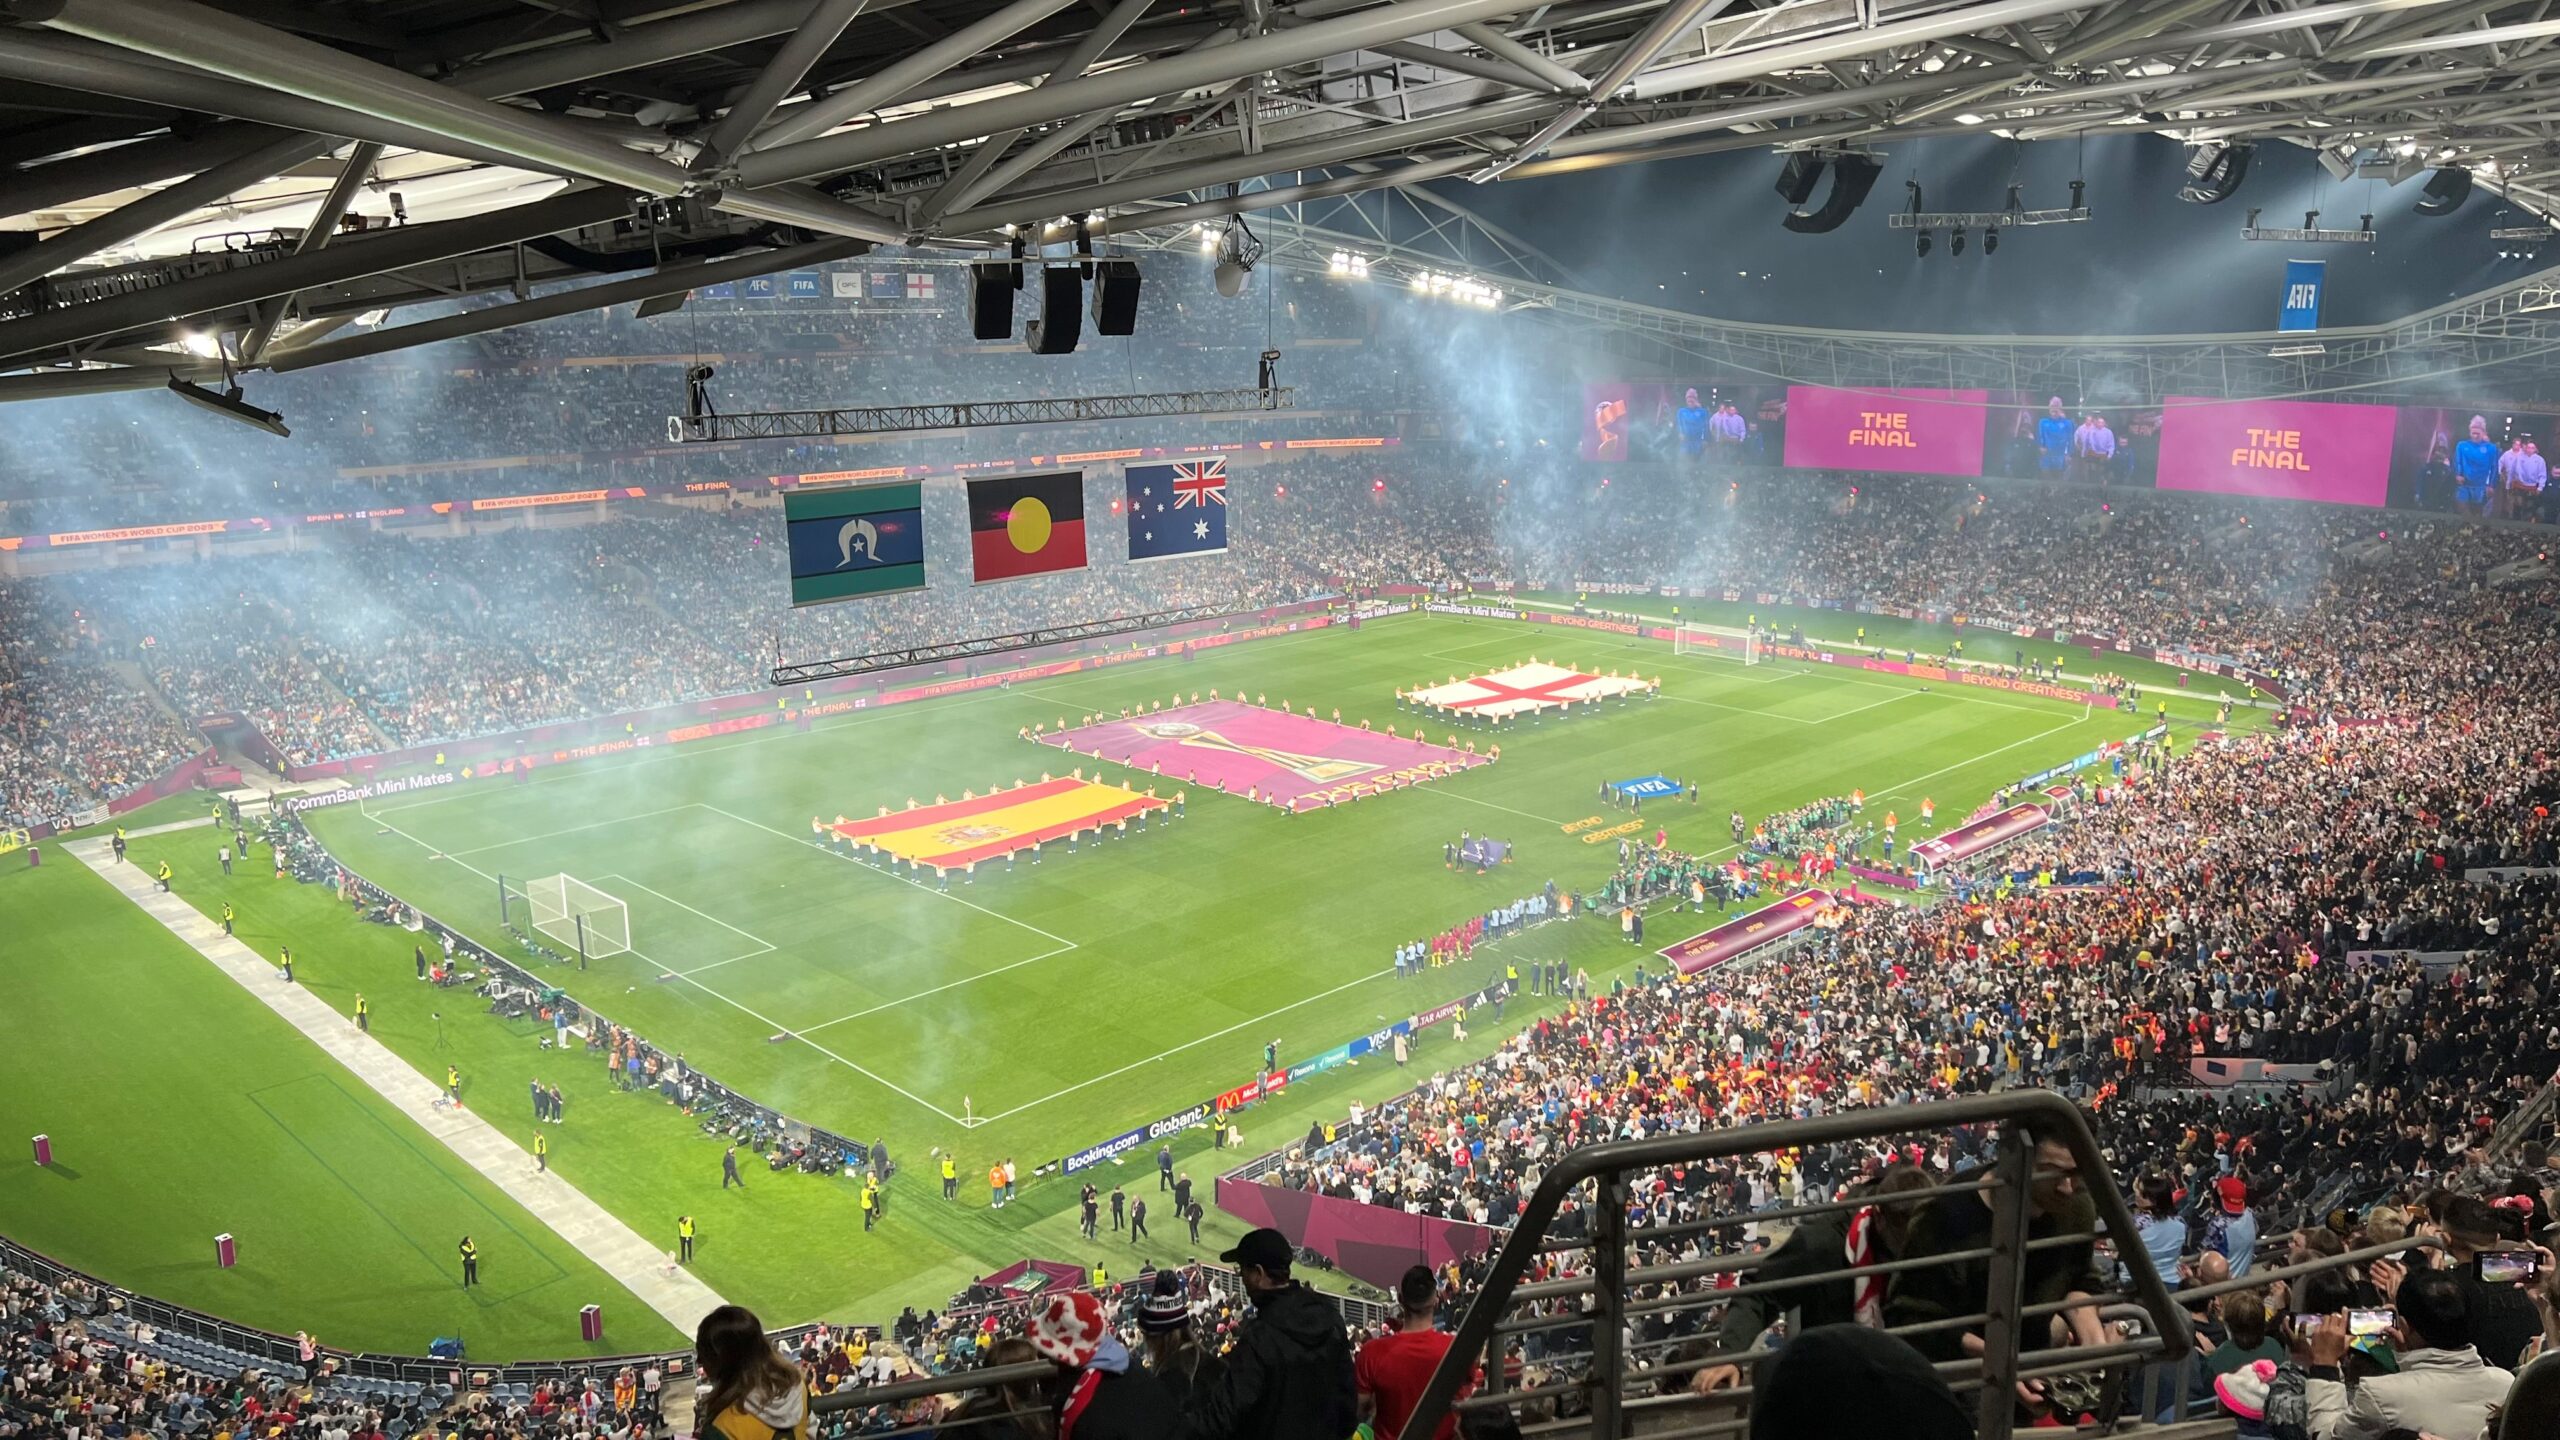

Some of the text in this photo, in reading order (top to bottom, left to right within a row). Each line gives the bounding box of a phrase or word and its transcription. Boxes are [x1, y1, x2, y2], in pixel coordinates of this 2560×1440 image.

[749, 280, 768, 291] AFC
[794, 281, 814, 290] FIFA
[1861, 412, 1908, 430] THE
[1849, 429, 1917, 448] FINAL
[2246, 429, 2301, 450] THE
[2232, 448, 2311, 471] FINAL
[685, 482, 730, 492] THE FINAL
[534, 496, 560, 504] WORLD
[82, 531, 128, 541] WOMEN'S
[130, 528, 164, 538] WORLD
[166, 526, 185, 534] CUP
[1389, 604, 1408, 614] Mates
[1424, 603, 1516, 619] CommBank Mini Mates
[1551, 615, 1586, 627] BEYOND
[1253, 626, 1287, 638] THE FINAL
[1106, 651, 1146, 664] THE FINAL
[1962, 674, 2010, 689] BEYOND
[924, 686, 940, 696] FIFA
[802, 702, 852, 716] THE FINAL
[571, 740, 633, 758] THE FINAL
[286, 772, 453, 811] CommBank Mini Mates
[1624, 780, 1672, 794] FIFA
[1368, 1028, 1392, 1048] VISA
[1325, 1051, 1345, 1064] Rexona
[1294, 1064, 1316, 1077] Rexona
[1150, 1107, 1202, 1138] Globant
[1068, 1133, 1139, 1172] Booking.com
